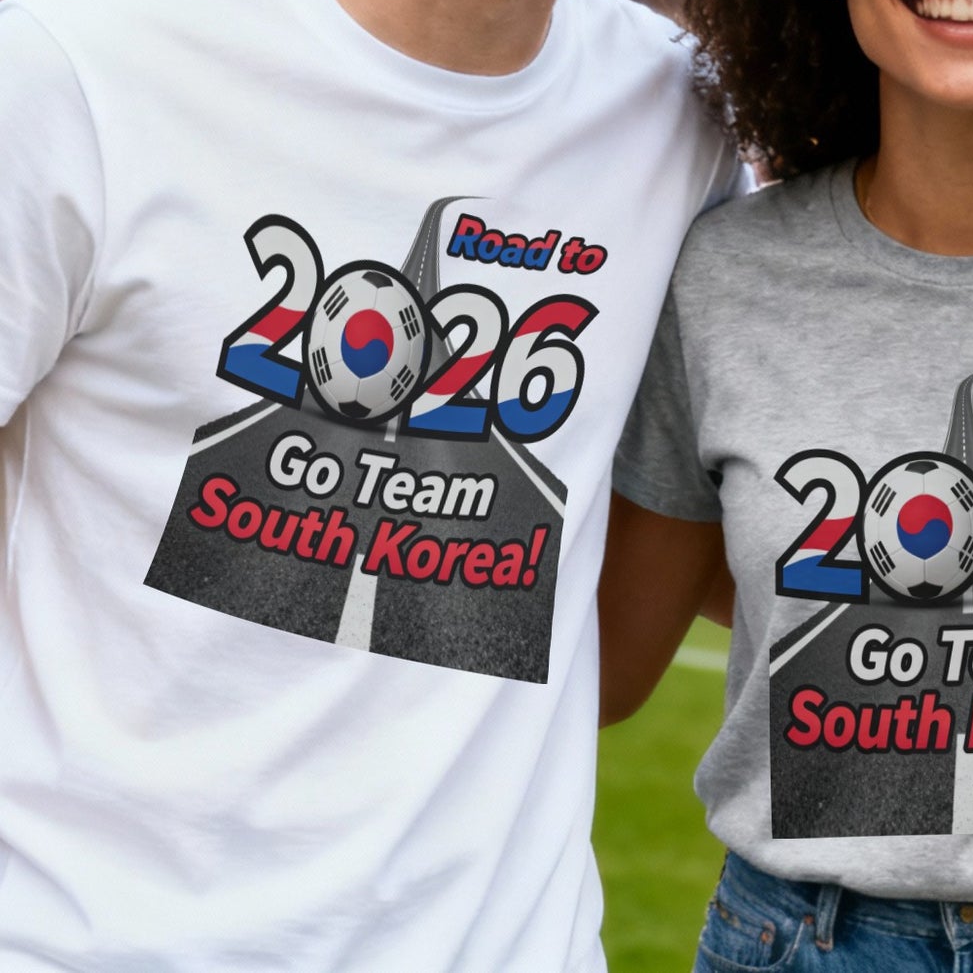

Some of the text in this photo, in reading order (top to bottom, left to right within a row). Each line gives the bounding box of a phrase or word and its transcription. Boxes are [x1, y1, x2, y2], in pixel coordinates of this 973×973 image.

[448, 213, 607, 275] Road to
[265, 430, 498, 522] Go Team
[187, 472, 550, 591] South Korea!
[846, 623, 928, 685] Go
[784, 684, 955, 753] South
